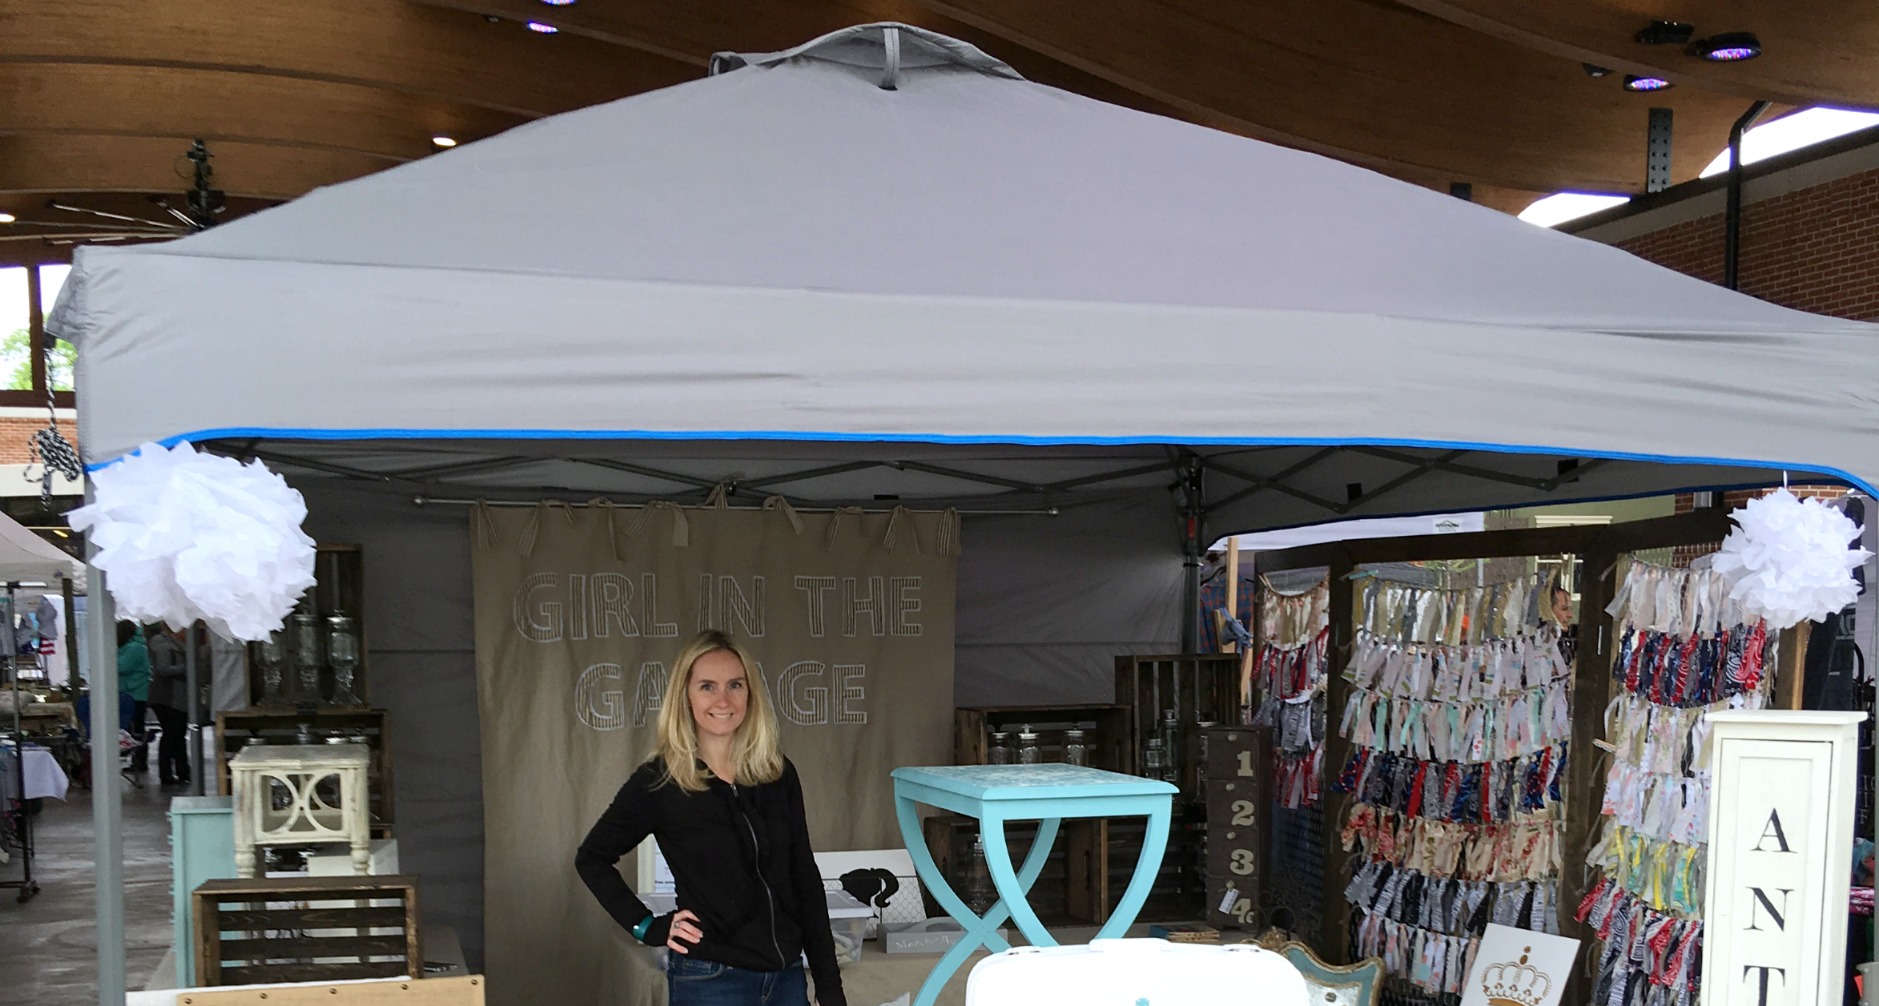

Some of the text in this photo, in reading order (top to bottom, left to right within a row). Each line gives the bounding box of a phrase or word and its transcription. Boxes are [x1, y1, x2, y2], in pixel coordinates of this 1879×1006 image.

[513, 571, 923, 643] GIRL IN THE
[574, 660, 868, 731] GAGE
[1236, 750, 1254, 777] 1
[1231, 800, 1255, 826] 2
[1229, 849, 1254, 875] 3
[1230, 898, 1255, 924] 4
